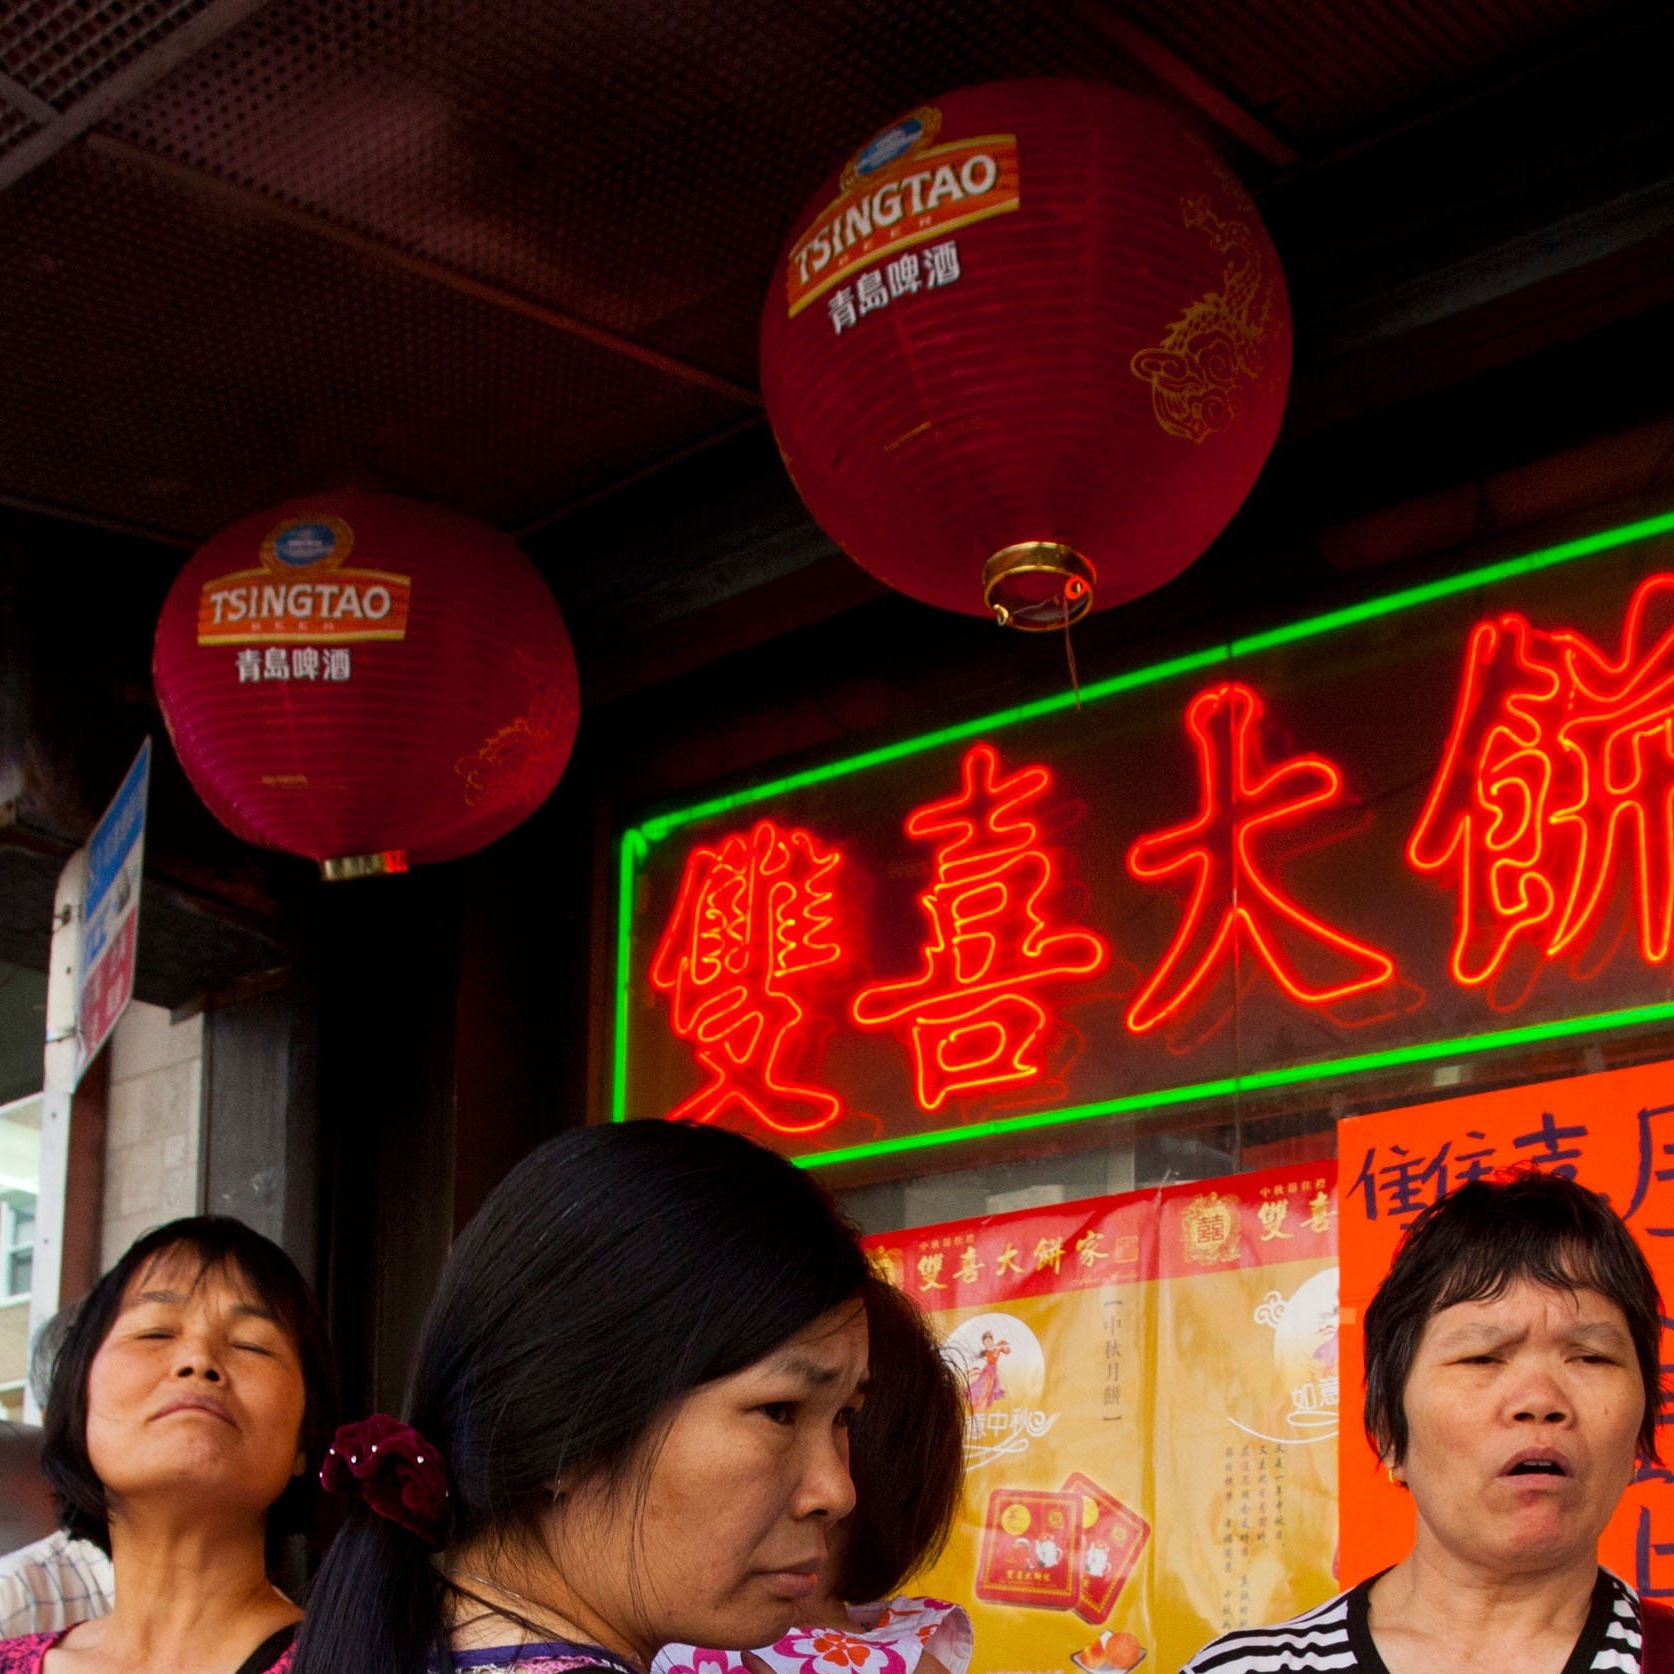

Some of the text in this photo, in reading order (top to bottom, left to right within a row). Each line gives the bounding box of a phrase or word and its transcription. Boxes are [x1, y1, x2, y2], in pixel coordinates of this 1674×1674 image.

[794, 154, 998, 286] TSINGTAO
[827, 239, 961, 337] 青島啤酒
[210, 583, 393, 625] TSINGTAO
[236, 645, 352, 683] 青島啤酒
[917, 1230, 1109, 1293] 雙喜大餅家
